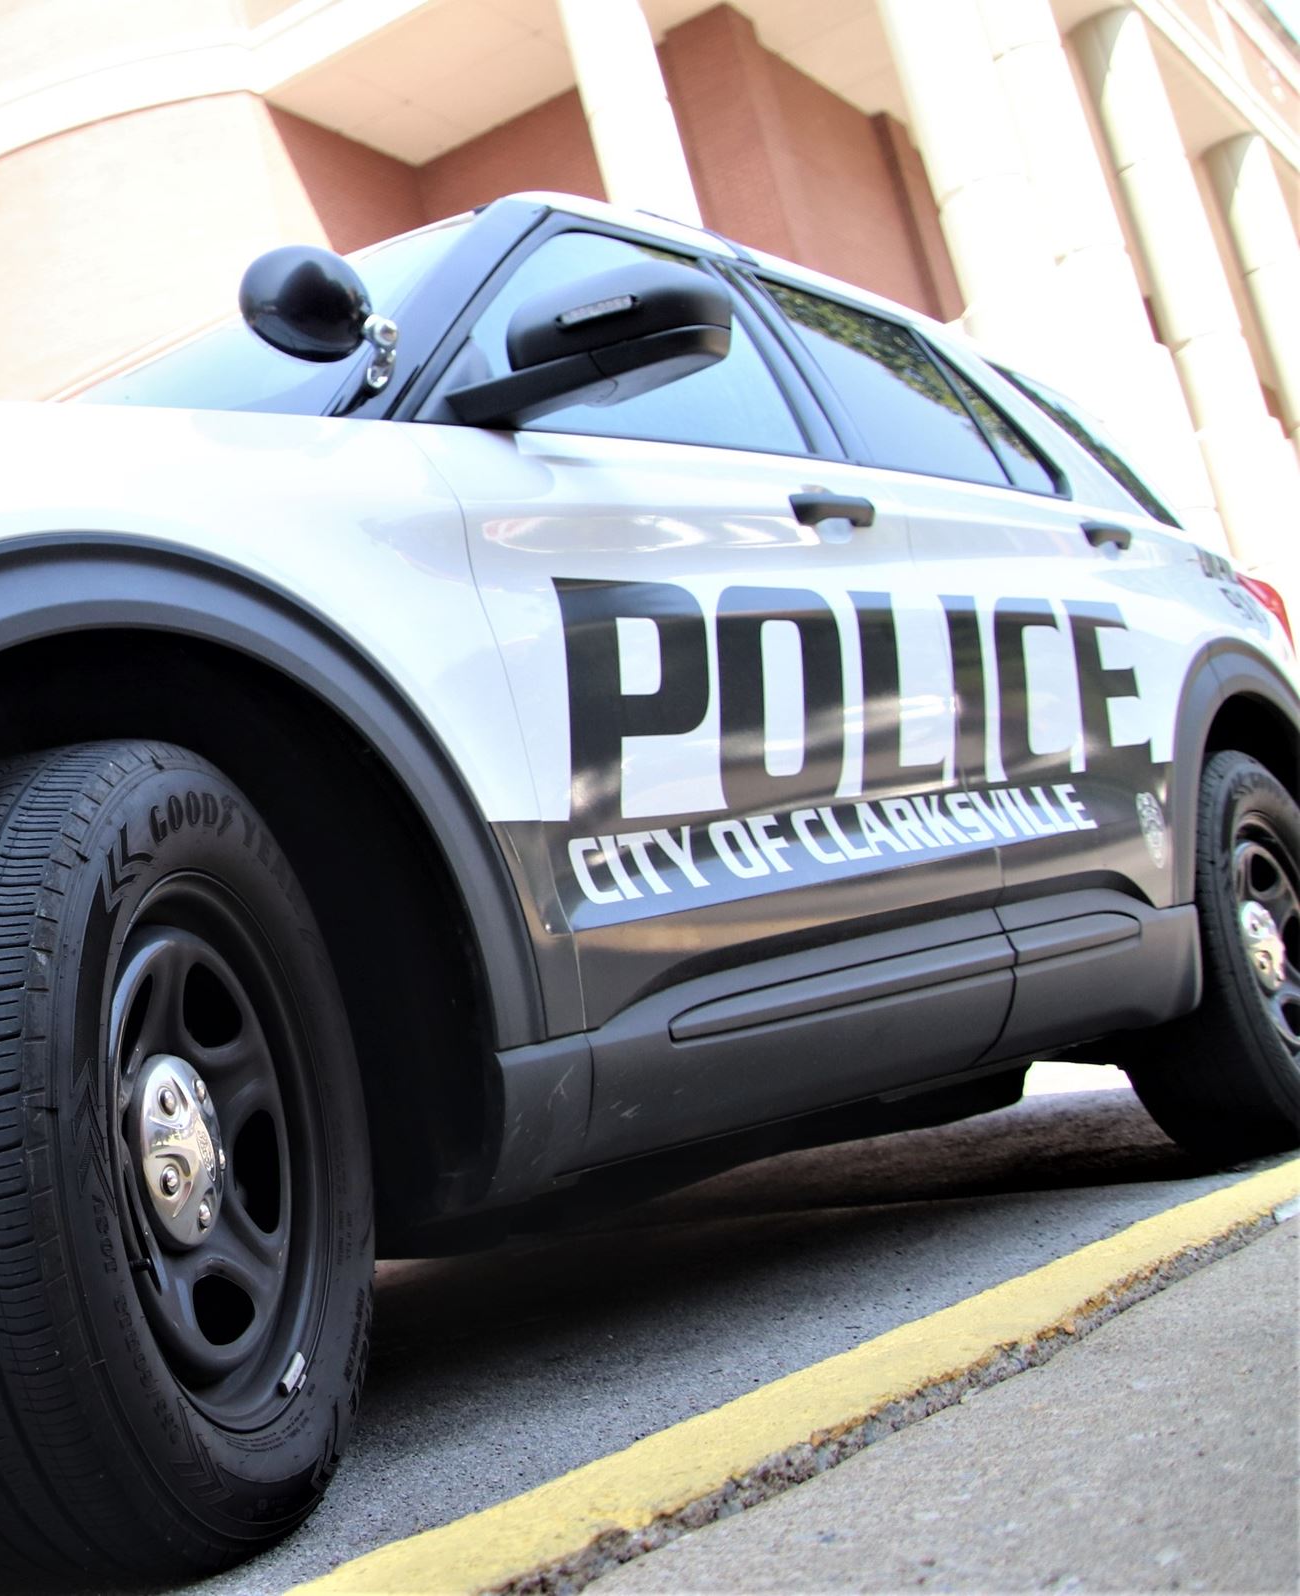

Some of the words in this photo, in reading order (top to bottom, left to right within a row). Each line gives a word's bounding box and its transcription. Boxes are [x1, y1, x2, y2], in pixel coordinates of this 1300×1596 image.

[551, 577, 1152, 820] POLICE
[568, 826, 709, 904] CITY
[708, 817, 793, 876] OF
[801, 783, 1096, 864] CLARKSVILLE
